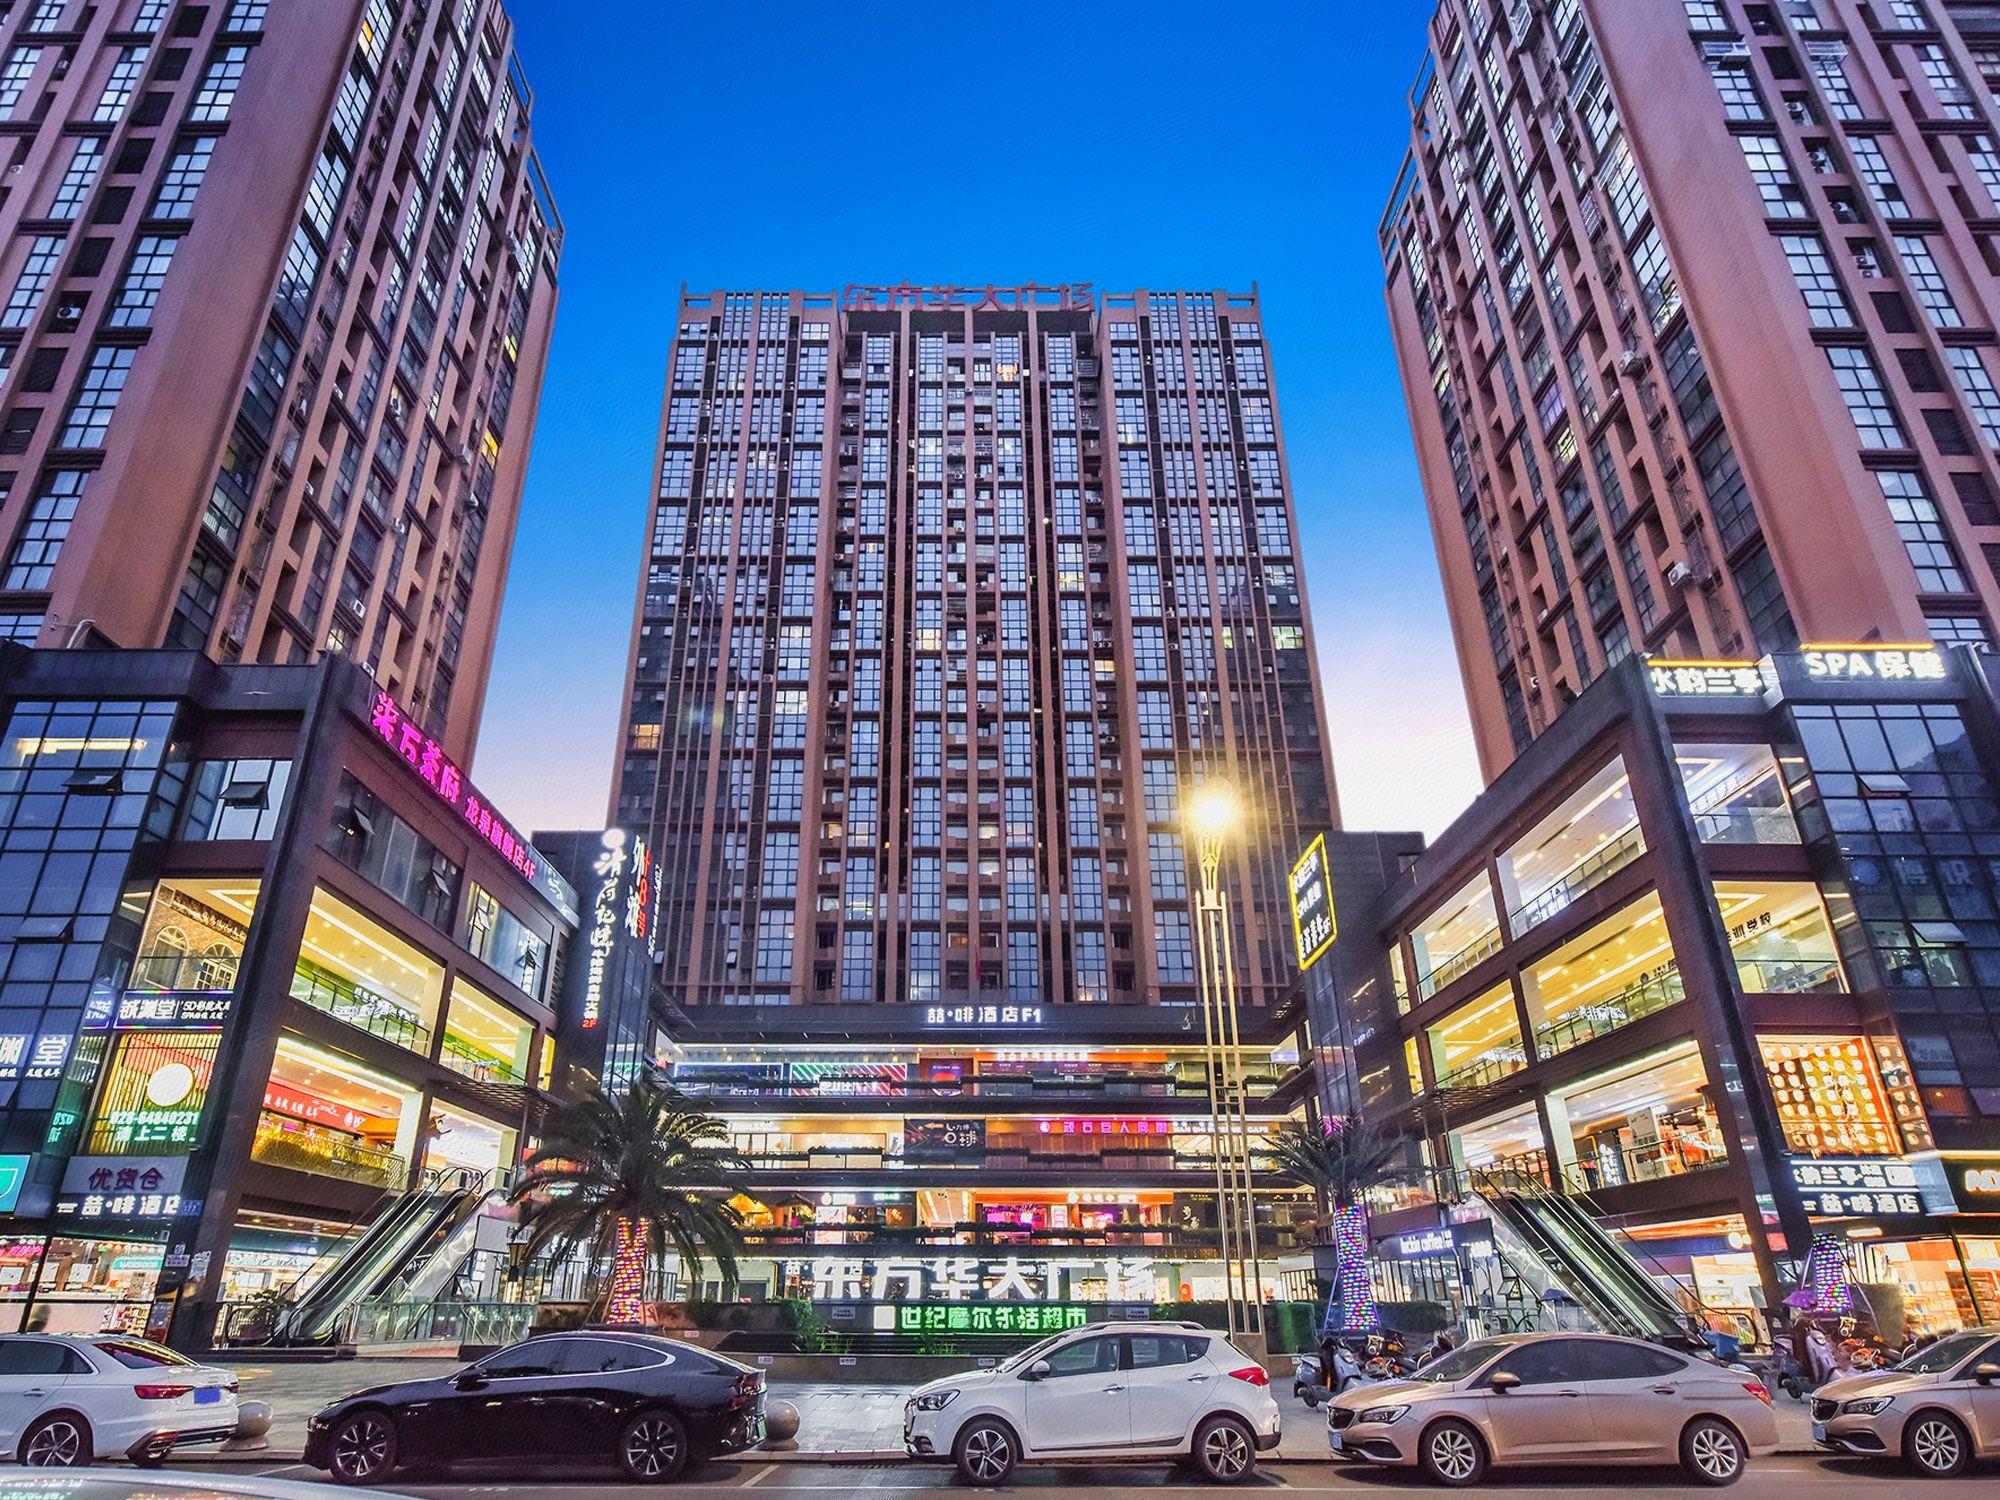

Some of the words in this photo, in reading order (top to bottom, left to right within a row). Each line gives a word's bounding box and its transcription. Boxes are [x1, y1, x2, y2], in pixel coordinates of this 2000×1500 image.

[1805, 652, 1873, 677] SPA
[1875, 650, 1946, 678] 保健
[582, 1019, 597, 1029] 2F
[88, 1166, 164, 1190] 优货仓
[812, 1256, 1155, 1299] 东方华大广场
